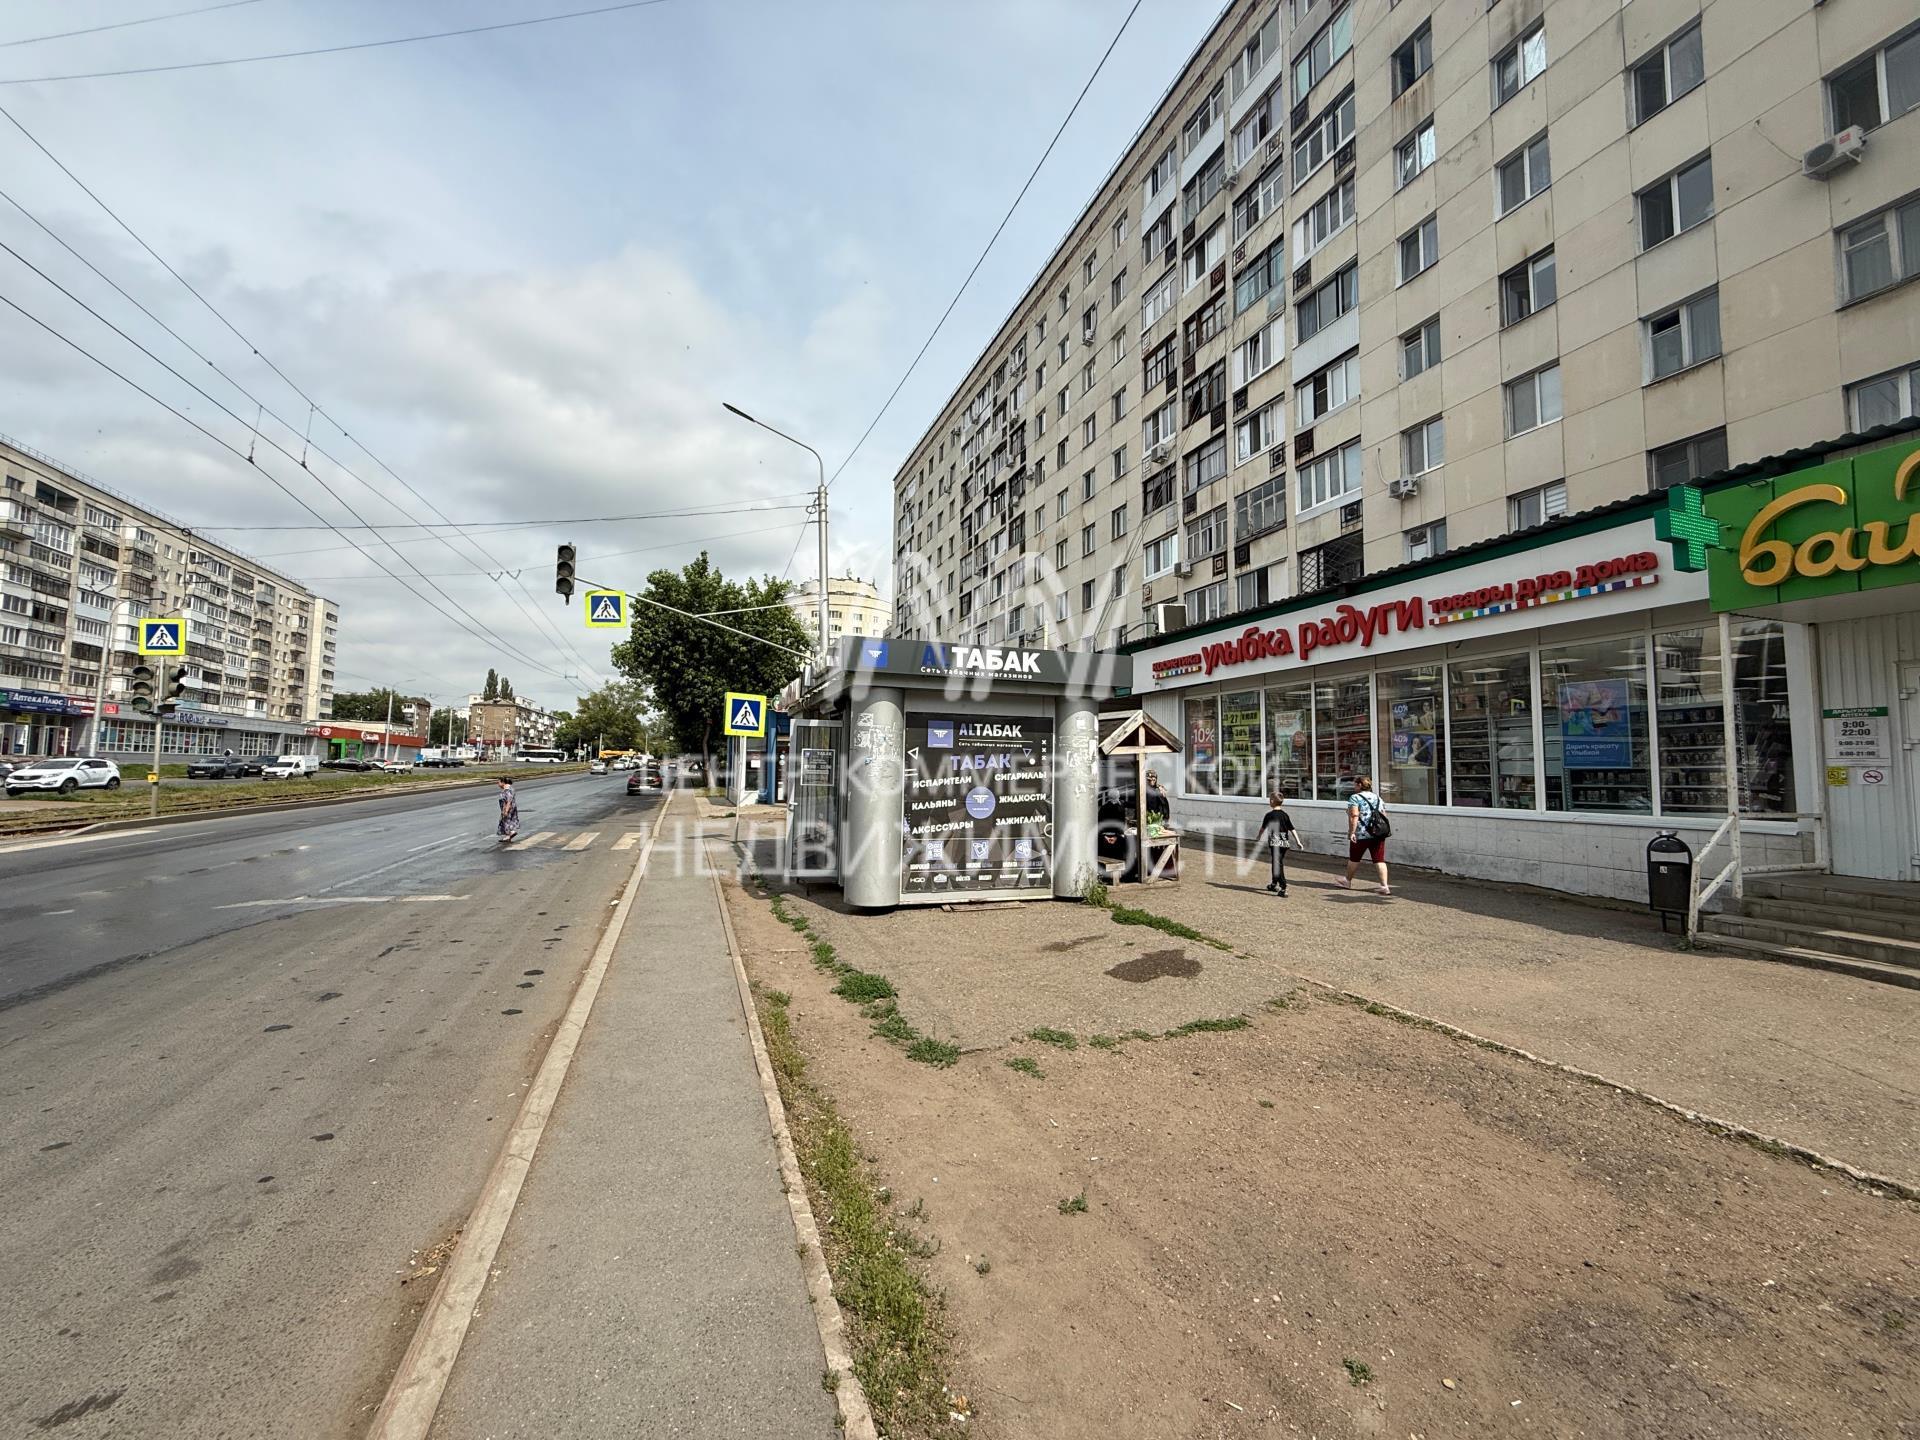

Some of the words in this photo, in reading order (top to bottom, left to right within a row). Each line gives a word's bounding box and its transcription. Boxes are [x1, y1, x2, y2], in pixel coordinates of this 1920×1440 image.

[1428, 582, 1512, 613] товары
[1516, 570, 1572, 600] для
[1574, 551, 1658, 589] дома
[1202, 627, 1294, 675] улыбка
[1299, 597, 1424, 660] радуги
[921, 666, 940, 674] Сеть
[951, 754, 1011, 770] ТАБАК
[994, 771, 1047, 781] СИГАРИЛЛЫ
[913, 776, 972, 788] ИСПАРИТЕЛИ
[999, 793, 1047, 803] ЖИДКОСТИ
[912, 799, 957, 810] КАЛЬЯНЫ
[995, 815, 1046, 826] ЗАЖИГАЛКИ
[912, 821, 974, 835] АКСЕССУАРЫ
